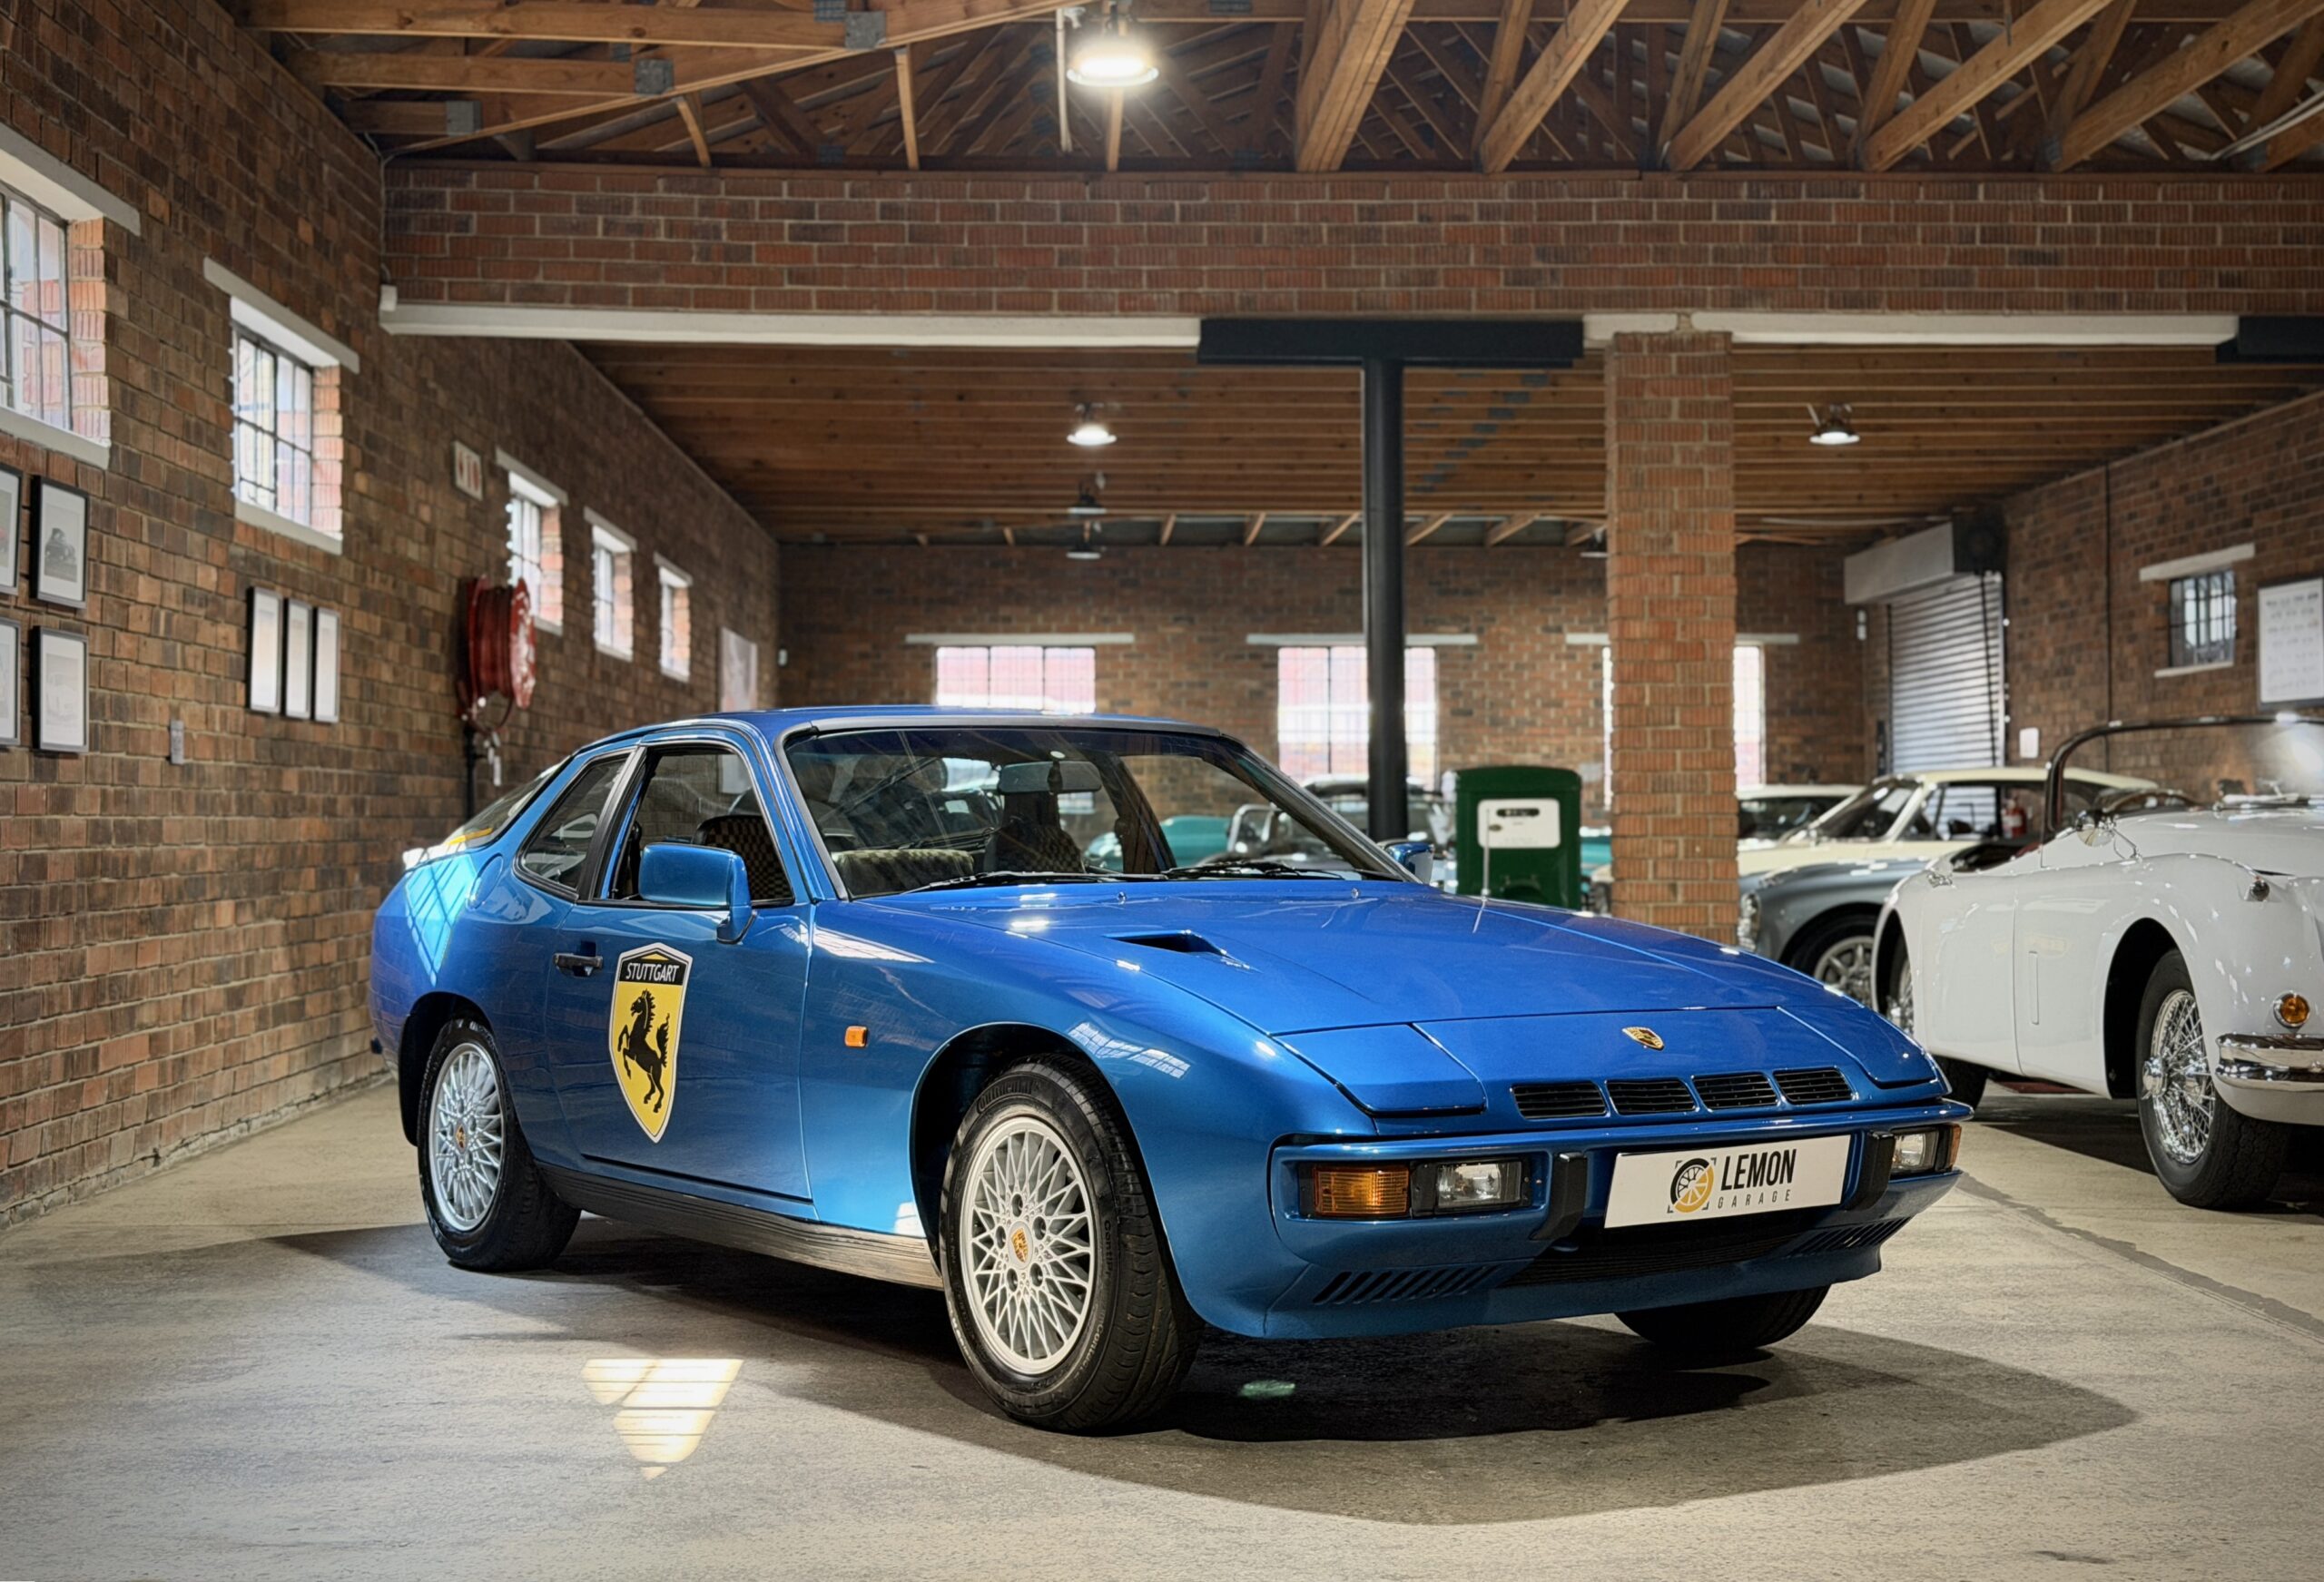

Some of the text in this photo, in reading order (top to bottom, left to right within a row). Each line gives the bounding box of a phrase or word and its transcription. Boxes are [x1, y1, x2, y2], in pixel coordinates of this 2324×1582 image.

[625, 962, 680, 982] STUTTGART
[1720, 1148, 1797, 1191] LEMON
[1718, 1189, 1791, 1210] GARAGE
